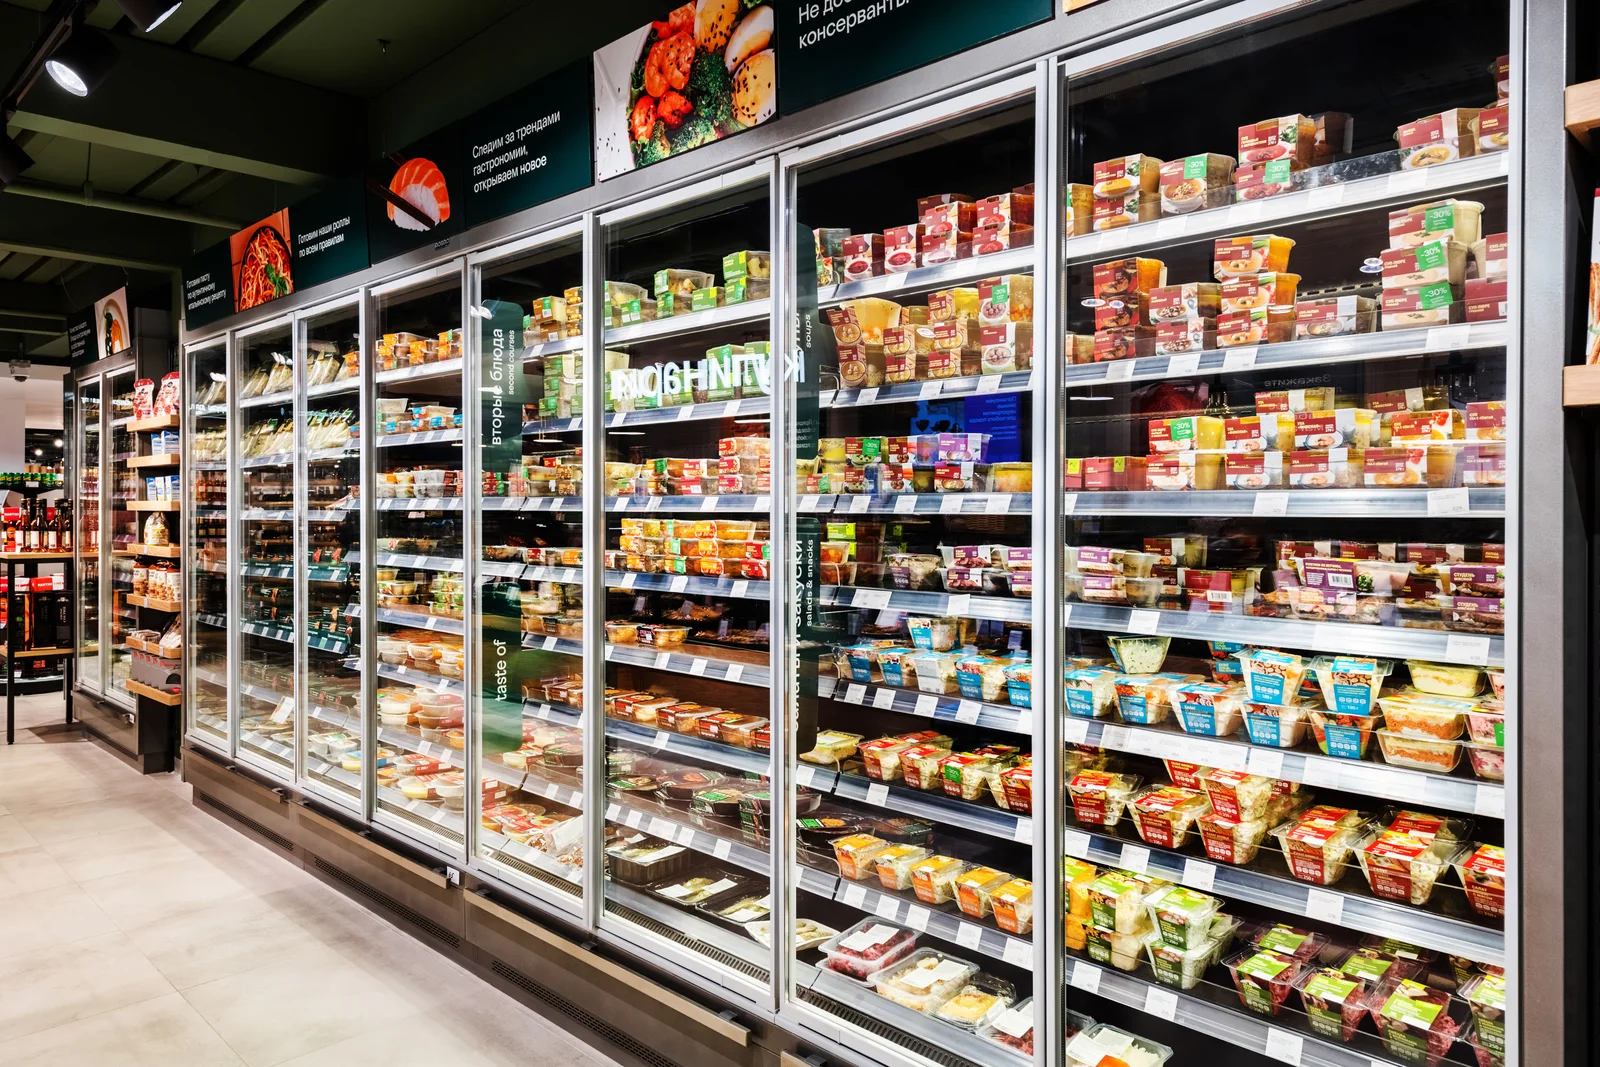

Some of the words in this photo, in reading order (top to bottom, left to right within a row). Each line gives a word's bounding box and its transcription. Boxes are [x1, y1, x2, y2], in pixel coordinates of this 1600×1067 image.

[798, 3, 820, 24] Не
[472, 136, 504, 158] Следим
[504, 132, 515, 144] за
[516, 110, 560, 140] трендами
[473, 145, 528, 176] гастрономии,
[1187, 160, 1204, 168] -30%
[1269, 164, 1287, 172] -30%
[474, 166, 519, 193] открываем
[520, 155, 547, 175] новое
[1429, 209, 1451, 218] -30%
[298, 230, 318, 244] Готовим
[319, 224, 332, 236] наши
[333, 216, 350, 233] роллы
[299, 249, 305, 258] по
[306, 244, 318, 255] всем
[319, 233, 344, 252] правилам
[1420, 247, 1441, 258] -30%
[1425, 287, 1448, 298] -30%
[490, 329, 503, 381] блюда
[806, 580, 812, 589] &
[493, 639, 506, 656] of
[495, 660, 506, 701] taste
